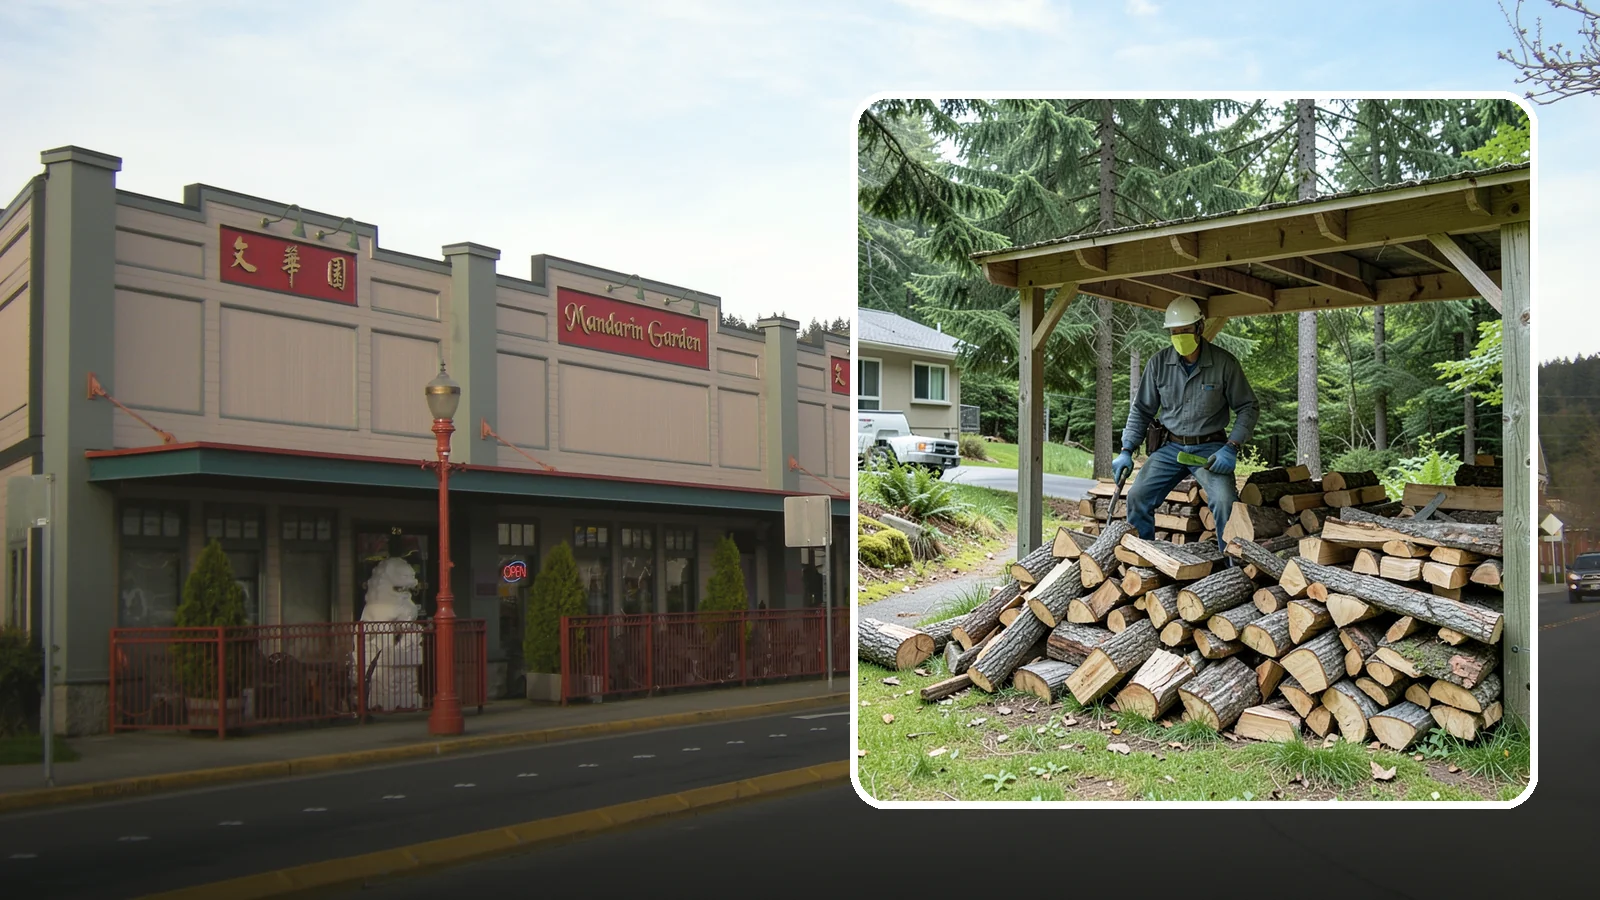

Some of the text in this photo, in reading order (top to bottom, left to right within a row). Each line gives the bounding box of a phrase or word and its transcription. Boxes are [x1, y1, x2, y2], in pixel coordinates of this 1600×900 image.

[231, 236, 346, 291] 文華園
[564, 302, 701, 352] Mandarin Garden
[503, 565, 527, 578] OPEN
